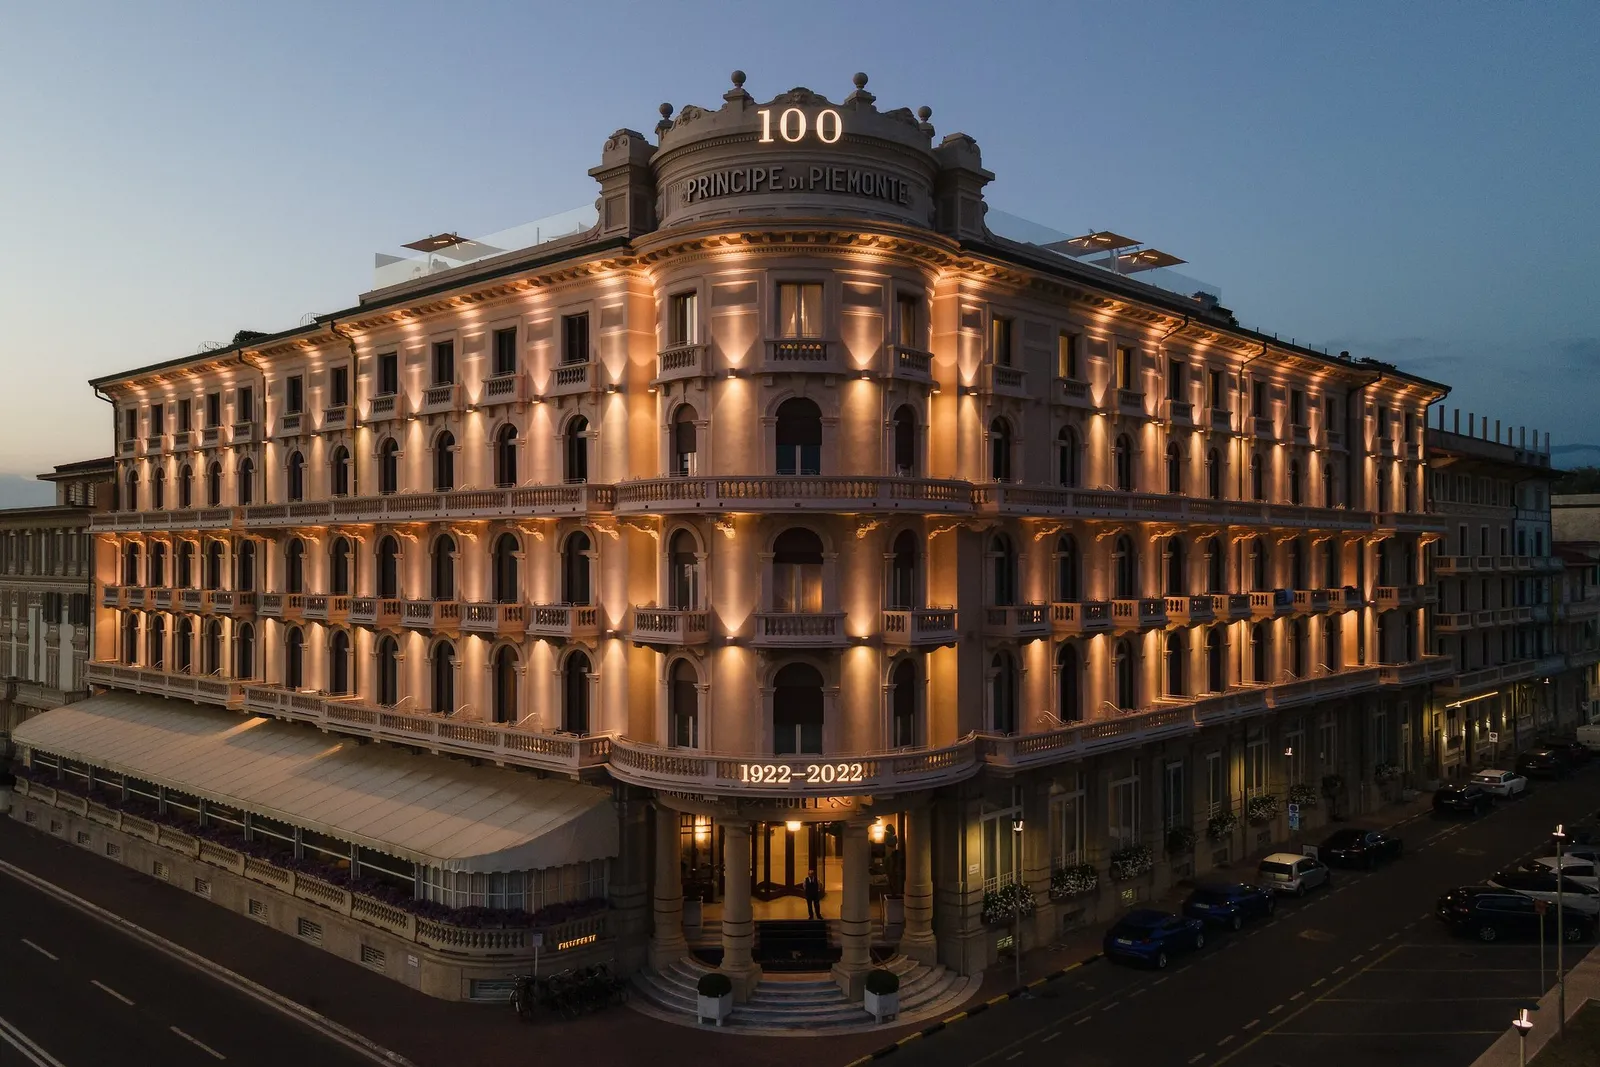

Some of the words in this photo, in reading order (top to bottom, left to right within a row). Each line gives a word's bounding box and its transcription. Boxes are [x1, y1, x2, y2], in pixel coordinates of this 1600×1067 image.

[757, 107, 843, 144] 100
[686, 165, 784, 203] PRINCIPE
[788, 176, 804, 191] DI
[808, 165, 910, 206] PIEMONTE
[776, 796, 823, 809] HOTEL
